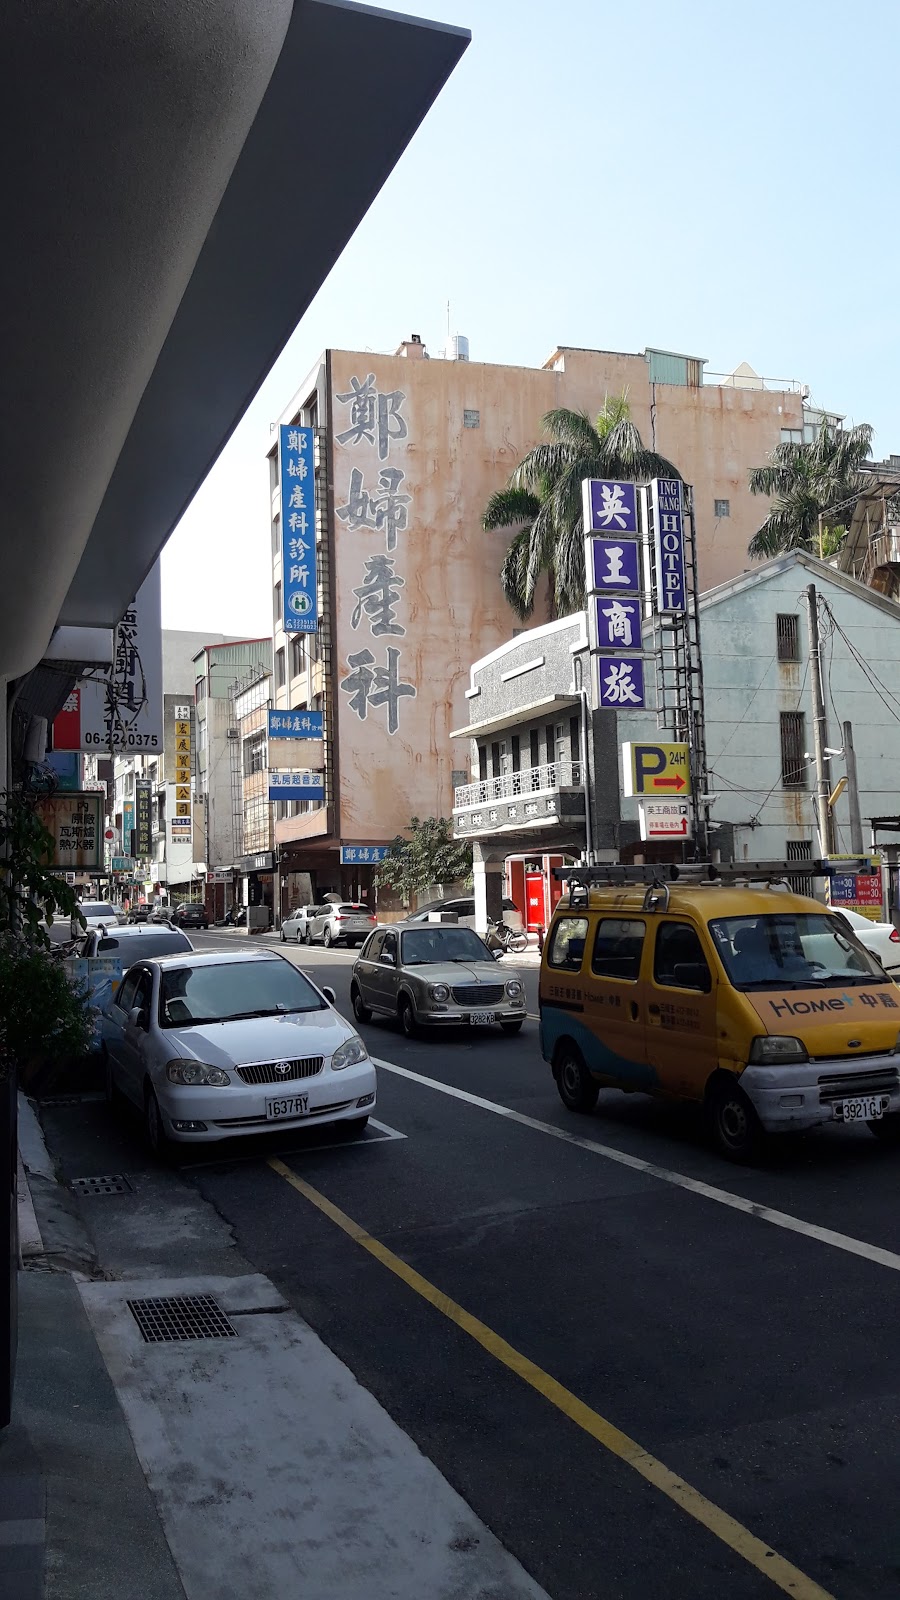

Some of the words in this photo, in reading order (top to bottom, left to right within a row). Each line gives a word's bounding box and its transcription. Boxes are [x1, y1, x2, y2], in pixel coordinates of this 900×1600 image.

[660, 481, 678, 496] ING
[287, 430, 311, 588] 鄭婦產科診所
[658, 496, 680, 511] WANG
[335, 372, 417, 736] 鄭婦產科
[661, 514, 683, 610] HOTEL
[597, 484, 642, 703] 英王商旅
[669, 751, 687, 766] 24H
[178, 723, 189, 815] 宏展貿易公司
[634, 746, 667, 793] P
[272, 775, 321, 785] 乳房超音波
[647, 805, 678, 815] 英王商旅
[71, 813, 95, 825] 原廠
[59, 826, 95, 838] 瓦斯爐
[59, 838, 95, 851] 熱水器
[859, 992, 899, 1008] 中嘉
